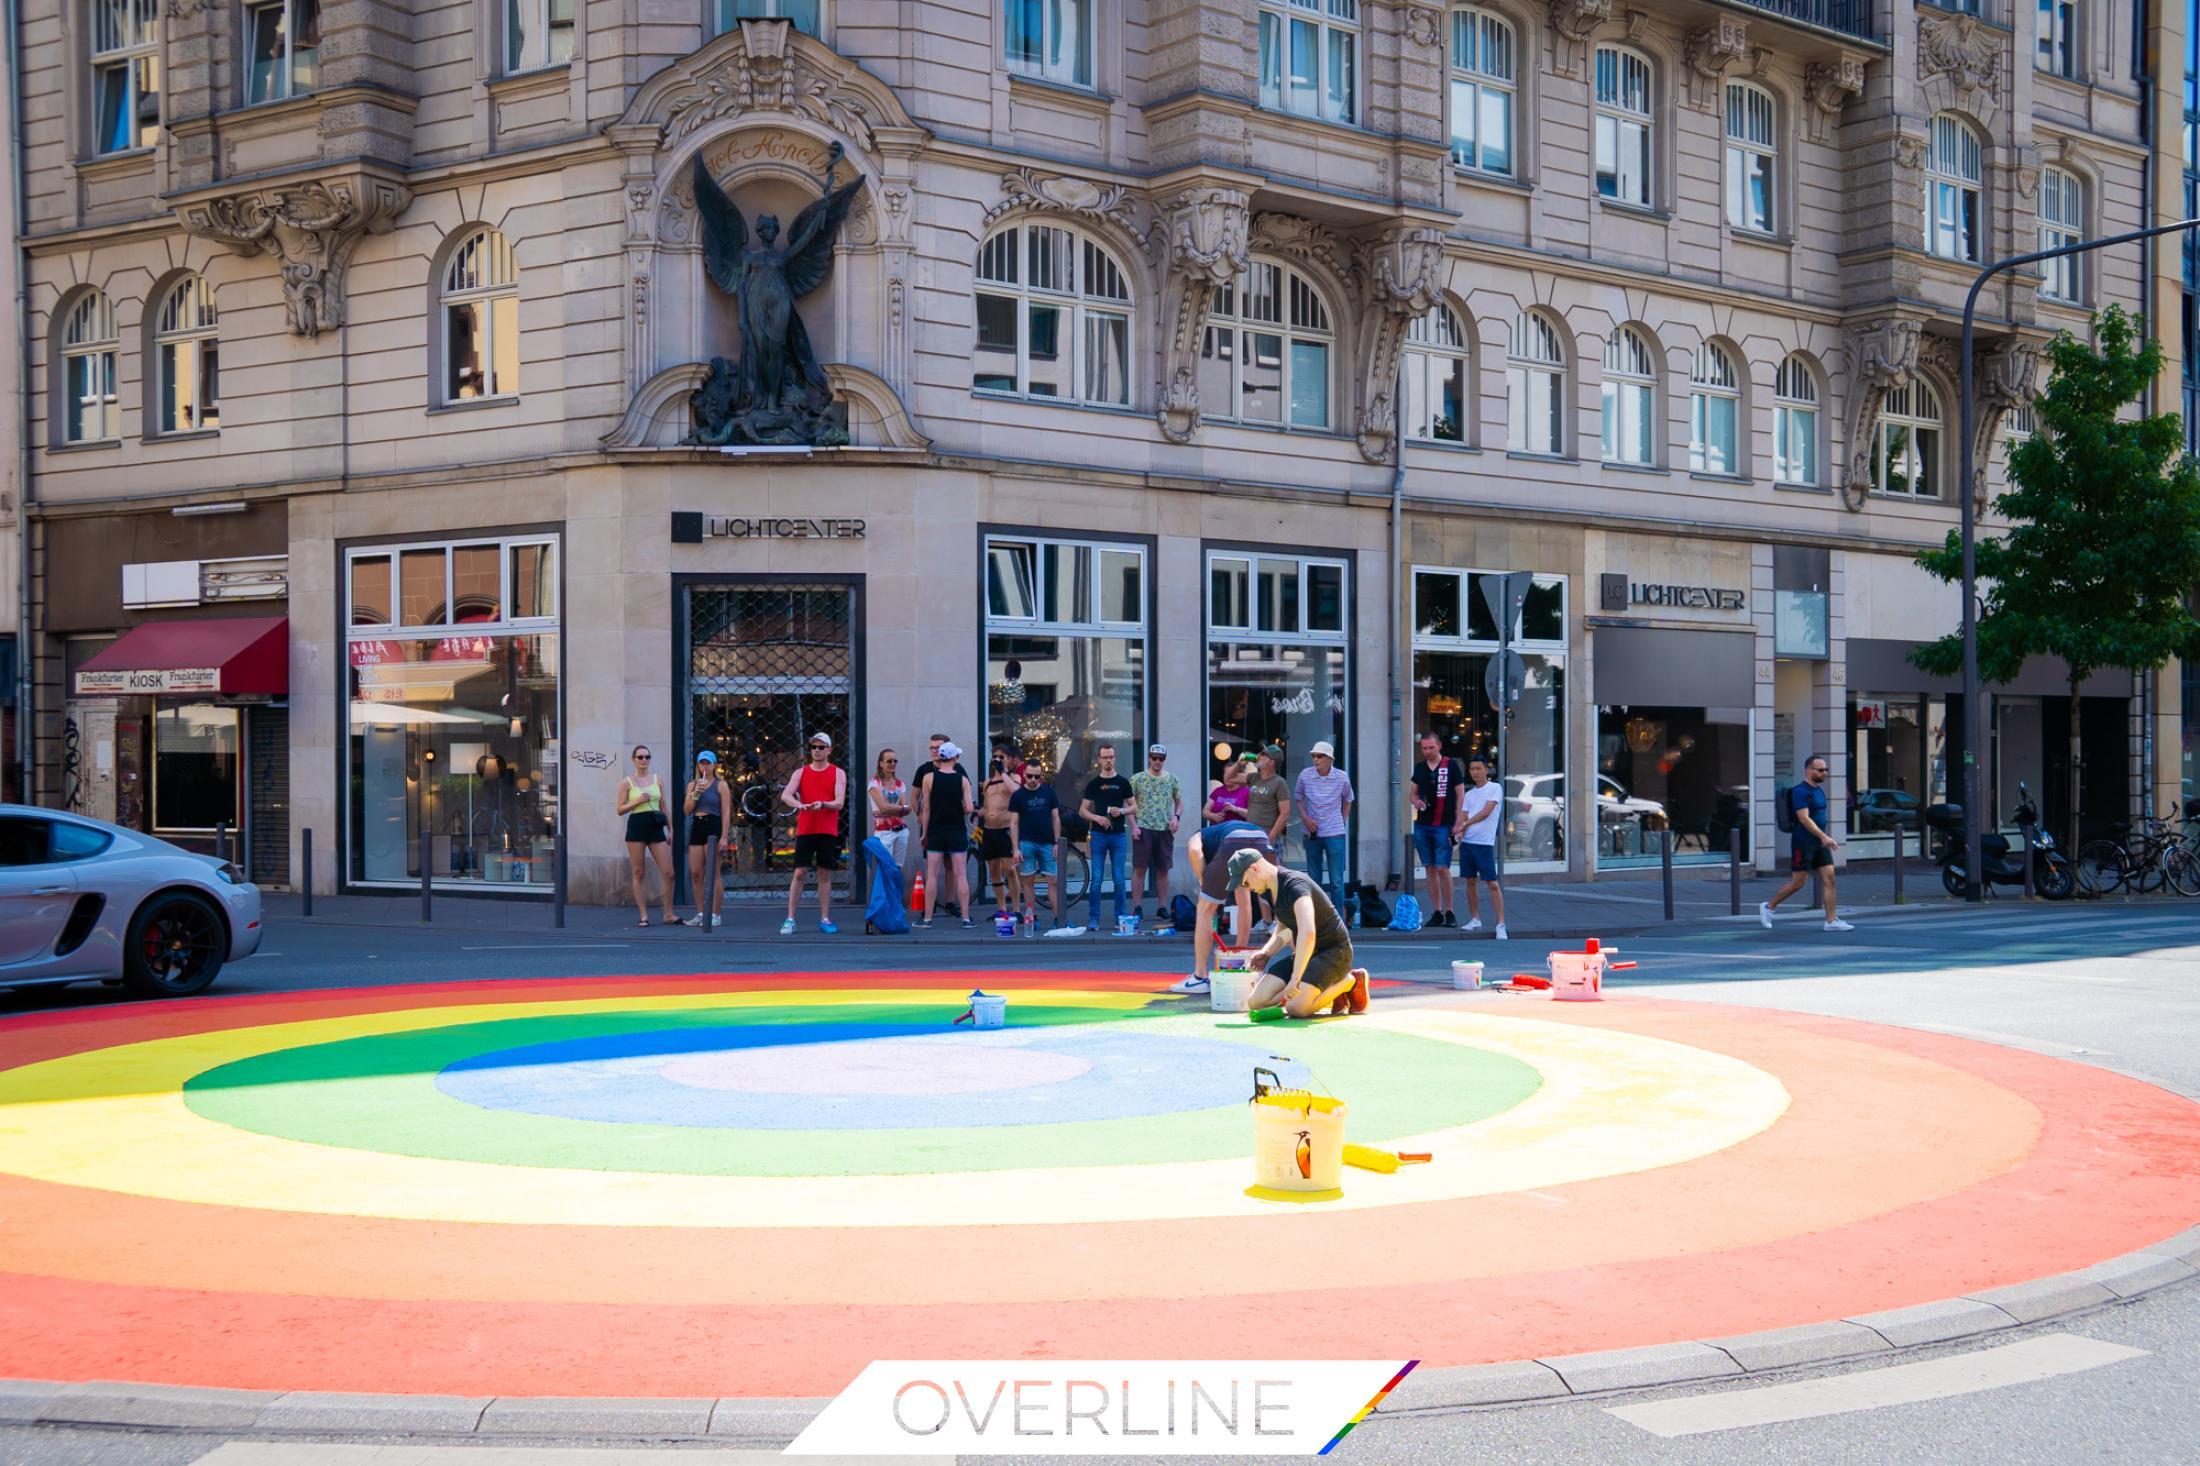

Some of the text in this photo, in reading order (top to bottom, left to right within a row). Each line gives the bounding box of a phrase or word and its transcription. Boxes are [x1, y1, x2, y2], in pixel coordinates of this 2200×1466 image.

[711, 519, 866, 537] LICHTCENTER
[1631, 583, 1745, 609] LICHTCENTER
[81, 671, 214, 687] Frankfurter KIOSK Frankfurter
